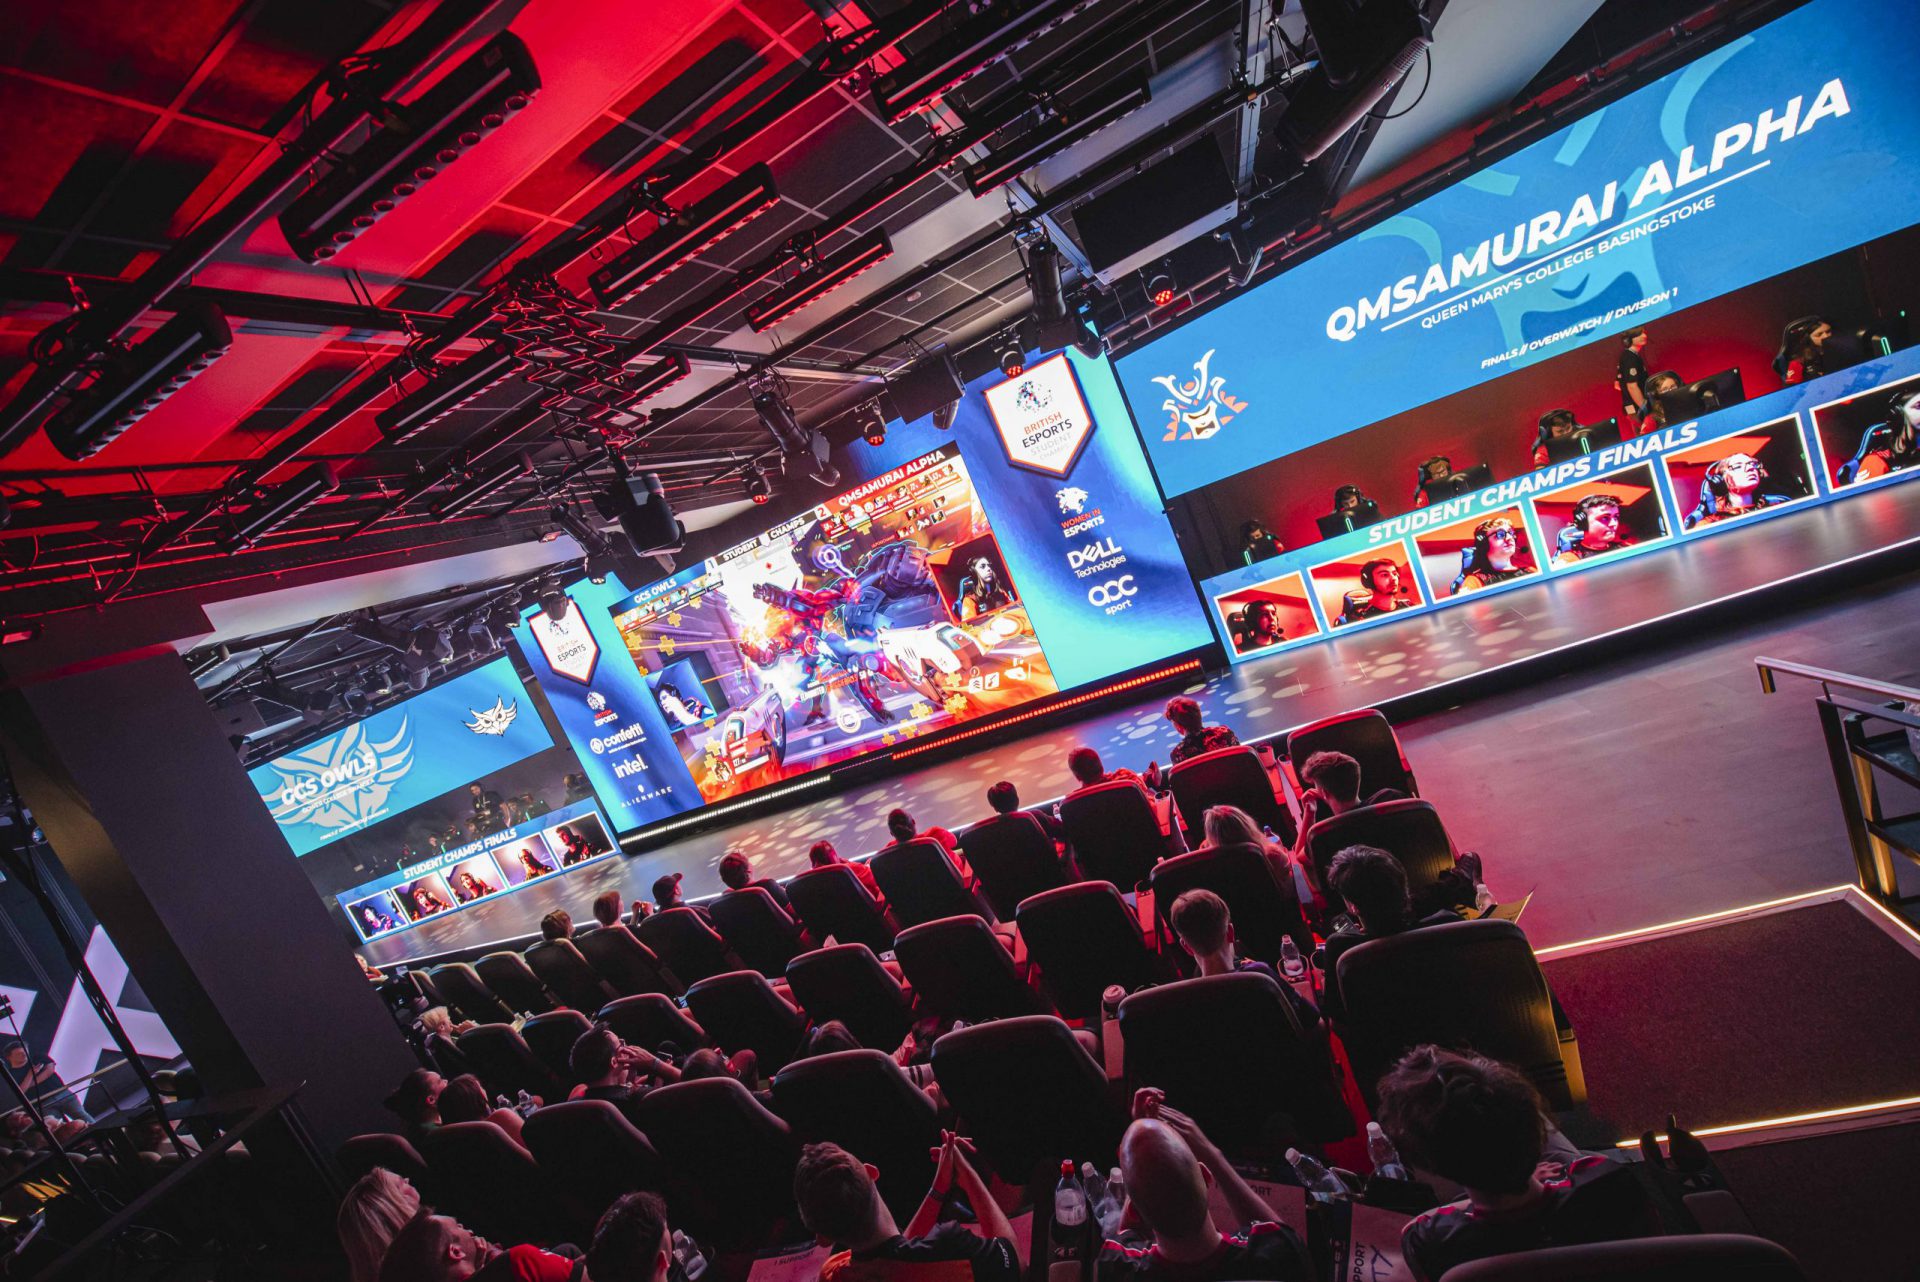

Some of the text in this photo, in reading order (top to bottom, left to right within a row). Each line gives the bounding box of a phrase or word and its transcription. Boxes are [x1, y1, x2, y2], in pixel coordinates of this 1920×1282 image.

[1326, 78, 1851, 341] QMSAMURAI ALPHA
[1421, 194, 1716, 329] QUEEN MARY'S COLLEGE BASINGSTOKE
[1480, 348, 1518, 370] FINALS
[1528, 315, 1602, 351] OVERWATCH
[1614, 290, 1671, 319] DIVISION
[1022, 418, 1073, 448] ESPORTS
[1023, 411, 1062, 435] BRITISH
[838, 450, 947, 507] QMSAMURAI ALPHA
[1368, 421, 1700, 545] STUDENT CHAMPS FINALS
[817, 507, 827, 518] 2
[1061, 508, 1102, 529] WOMEN IN
[1063, 515, 1105, 538] ESPORTS
[722, 541, 759, 562] STUDENT
[769, 517, 806, 539] CHAMPS
[1067, 537, 1123, 569] DELL
[1074, 555, 1127, 579] Technologies
[651, 578, 677, 596] OWLS
[1105, 598, 1133, 616] sport
[557, 643, 587, 662] ESPORTS
[602, 722, 645, 748] confetti
[320, 751, 377, 788] OWLS
[620, 786, 673, 808] ALIENWARE
[402, 828, 518, 880] STUDENT CHAMPS FINALS
